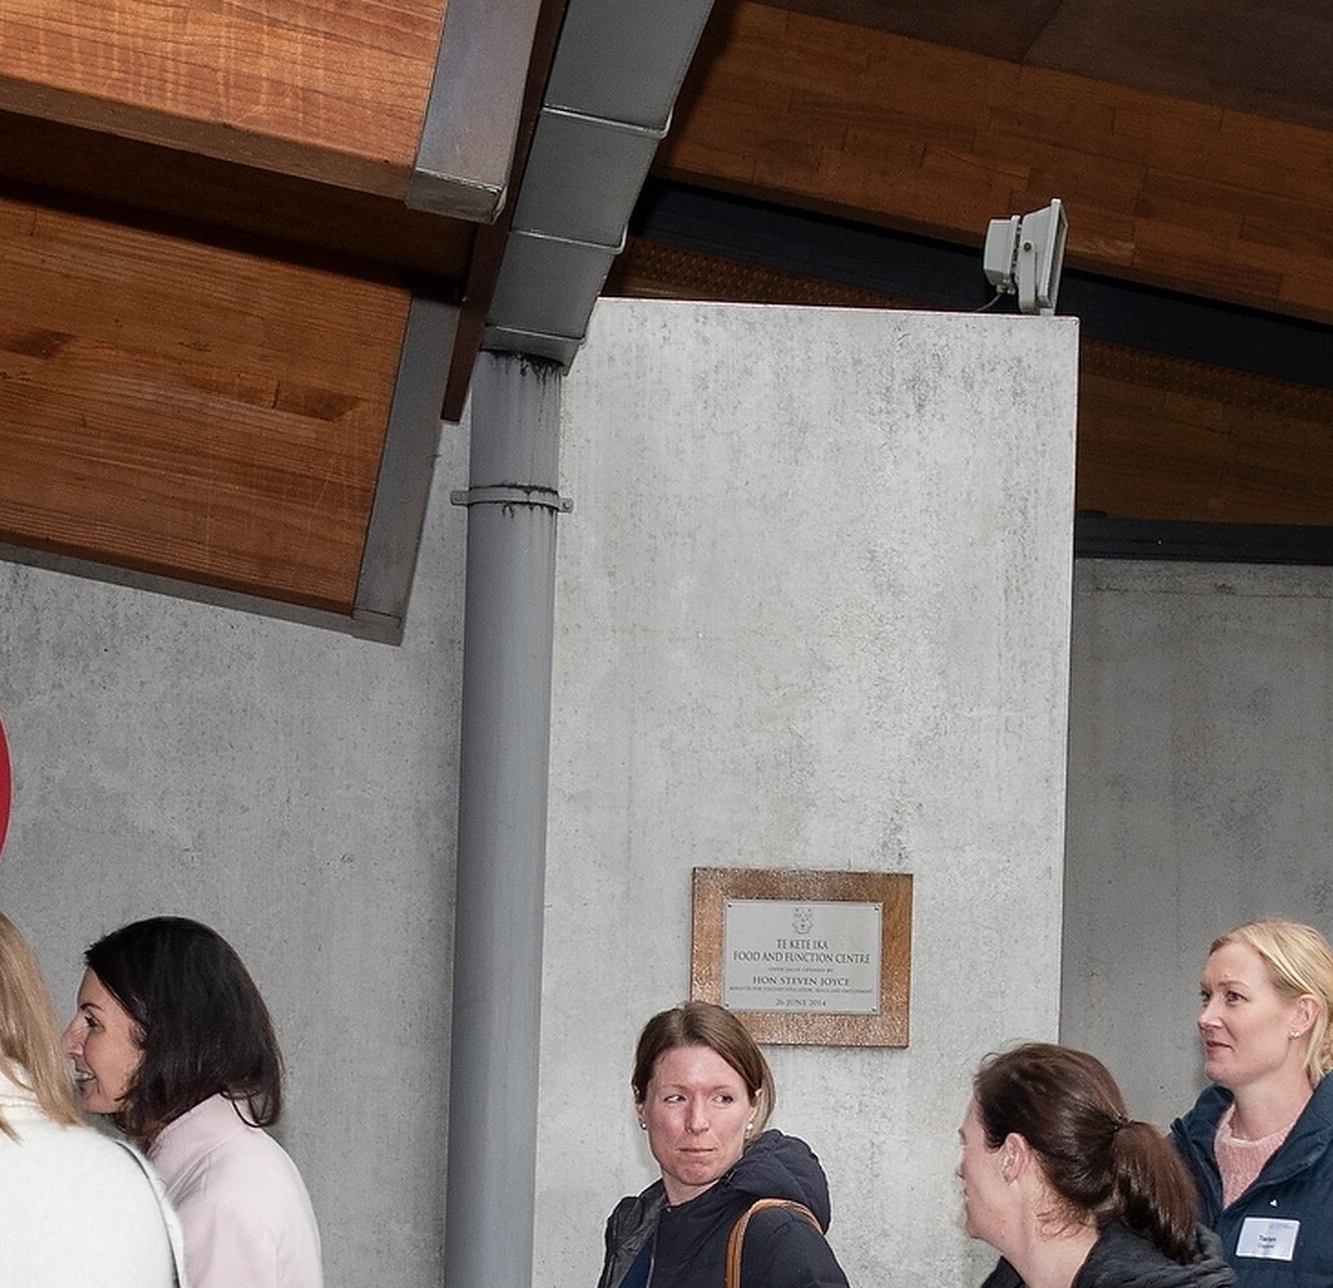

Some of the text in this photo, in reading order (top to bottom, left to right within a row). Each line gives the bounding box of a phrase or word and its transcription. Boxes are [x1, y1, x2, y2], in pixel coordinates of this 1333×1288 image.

[733, 951, 871, 964] FOOD AND FUNCTION CENTRE
[753, 976, 849, 987] HON STEVEN JOYCE
[786, 999, 807, 1008] JUNE
